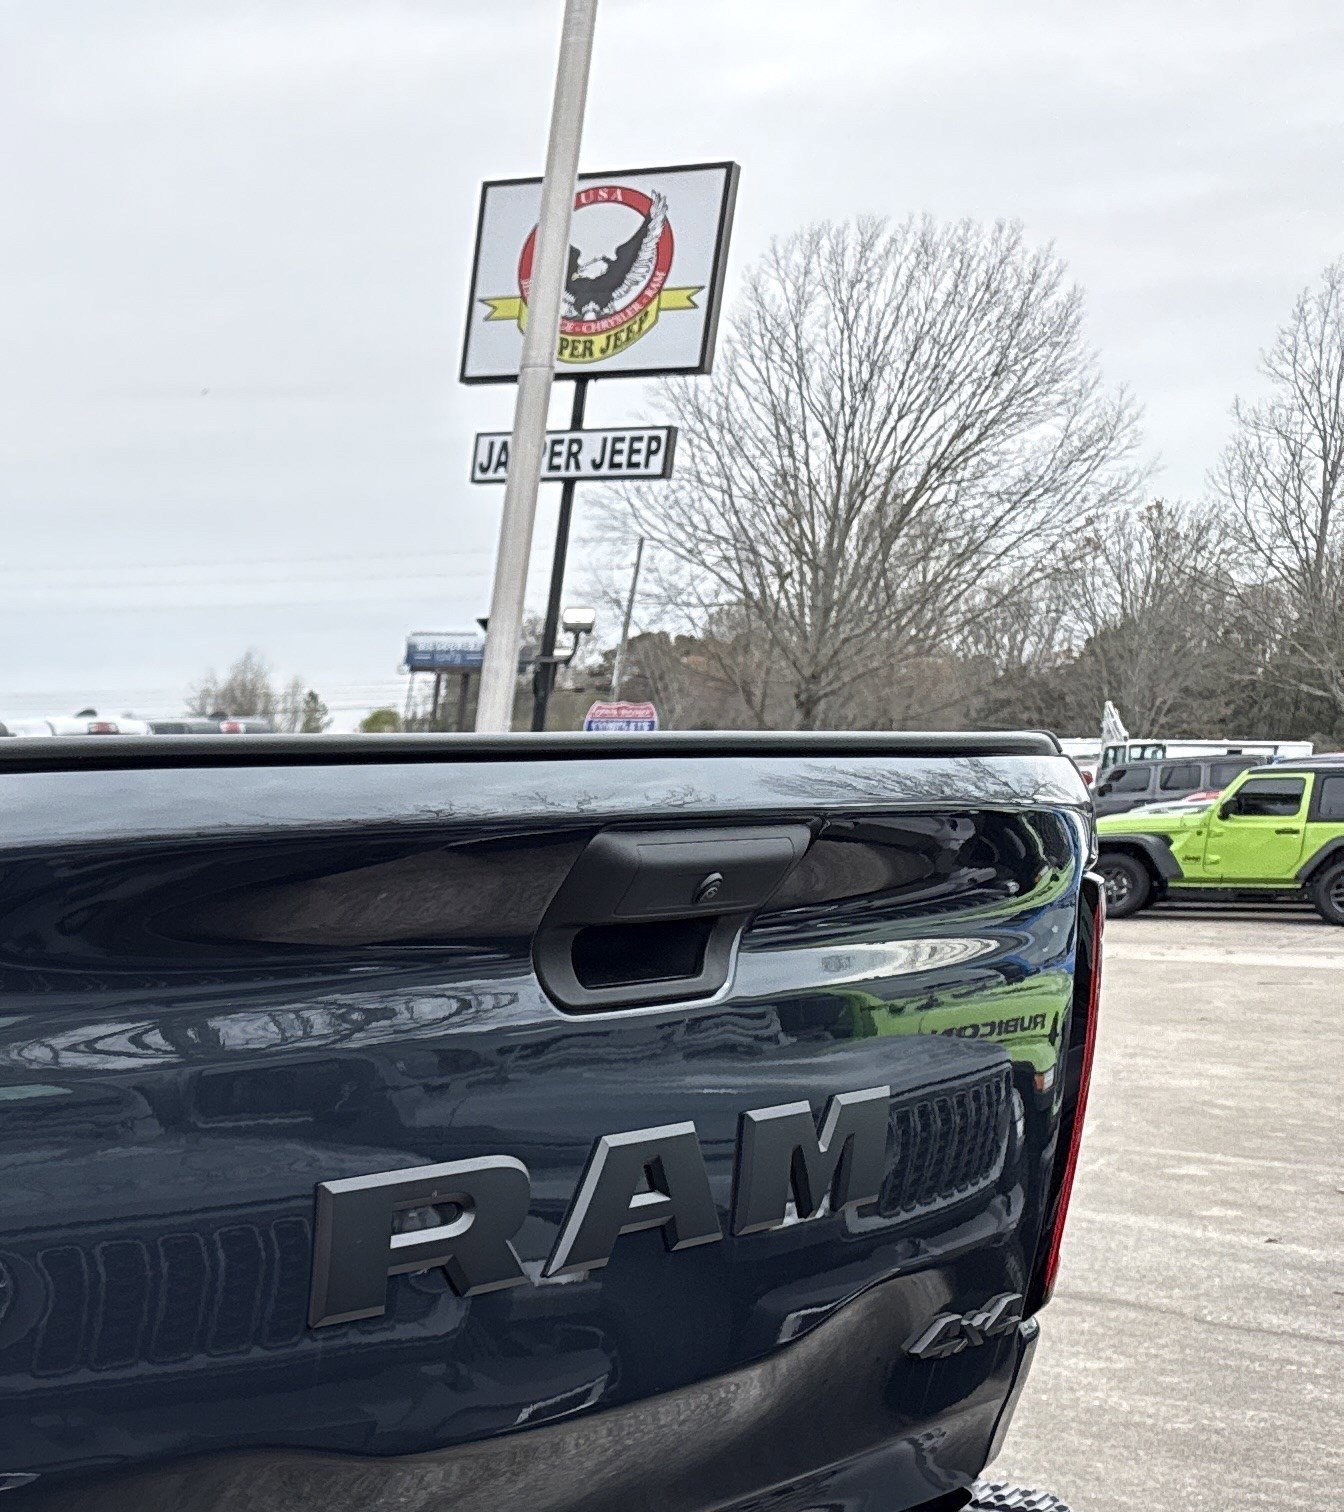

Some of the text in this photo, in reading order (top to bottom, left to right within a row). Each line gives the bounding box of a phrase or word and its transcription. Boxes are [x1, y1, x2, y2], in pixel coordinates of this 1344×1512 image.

[580, 187, 623, 204] USA
[558, 310, 650, 359] PER JEEP
[479, 435, 663, 474] JAER JEEP
[308, 1086, 891, 1329] RAM
